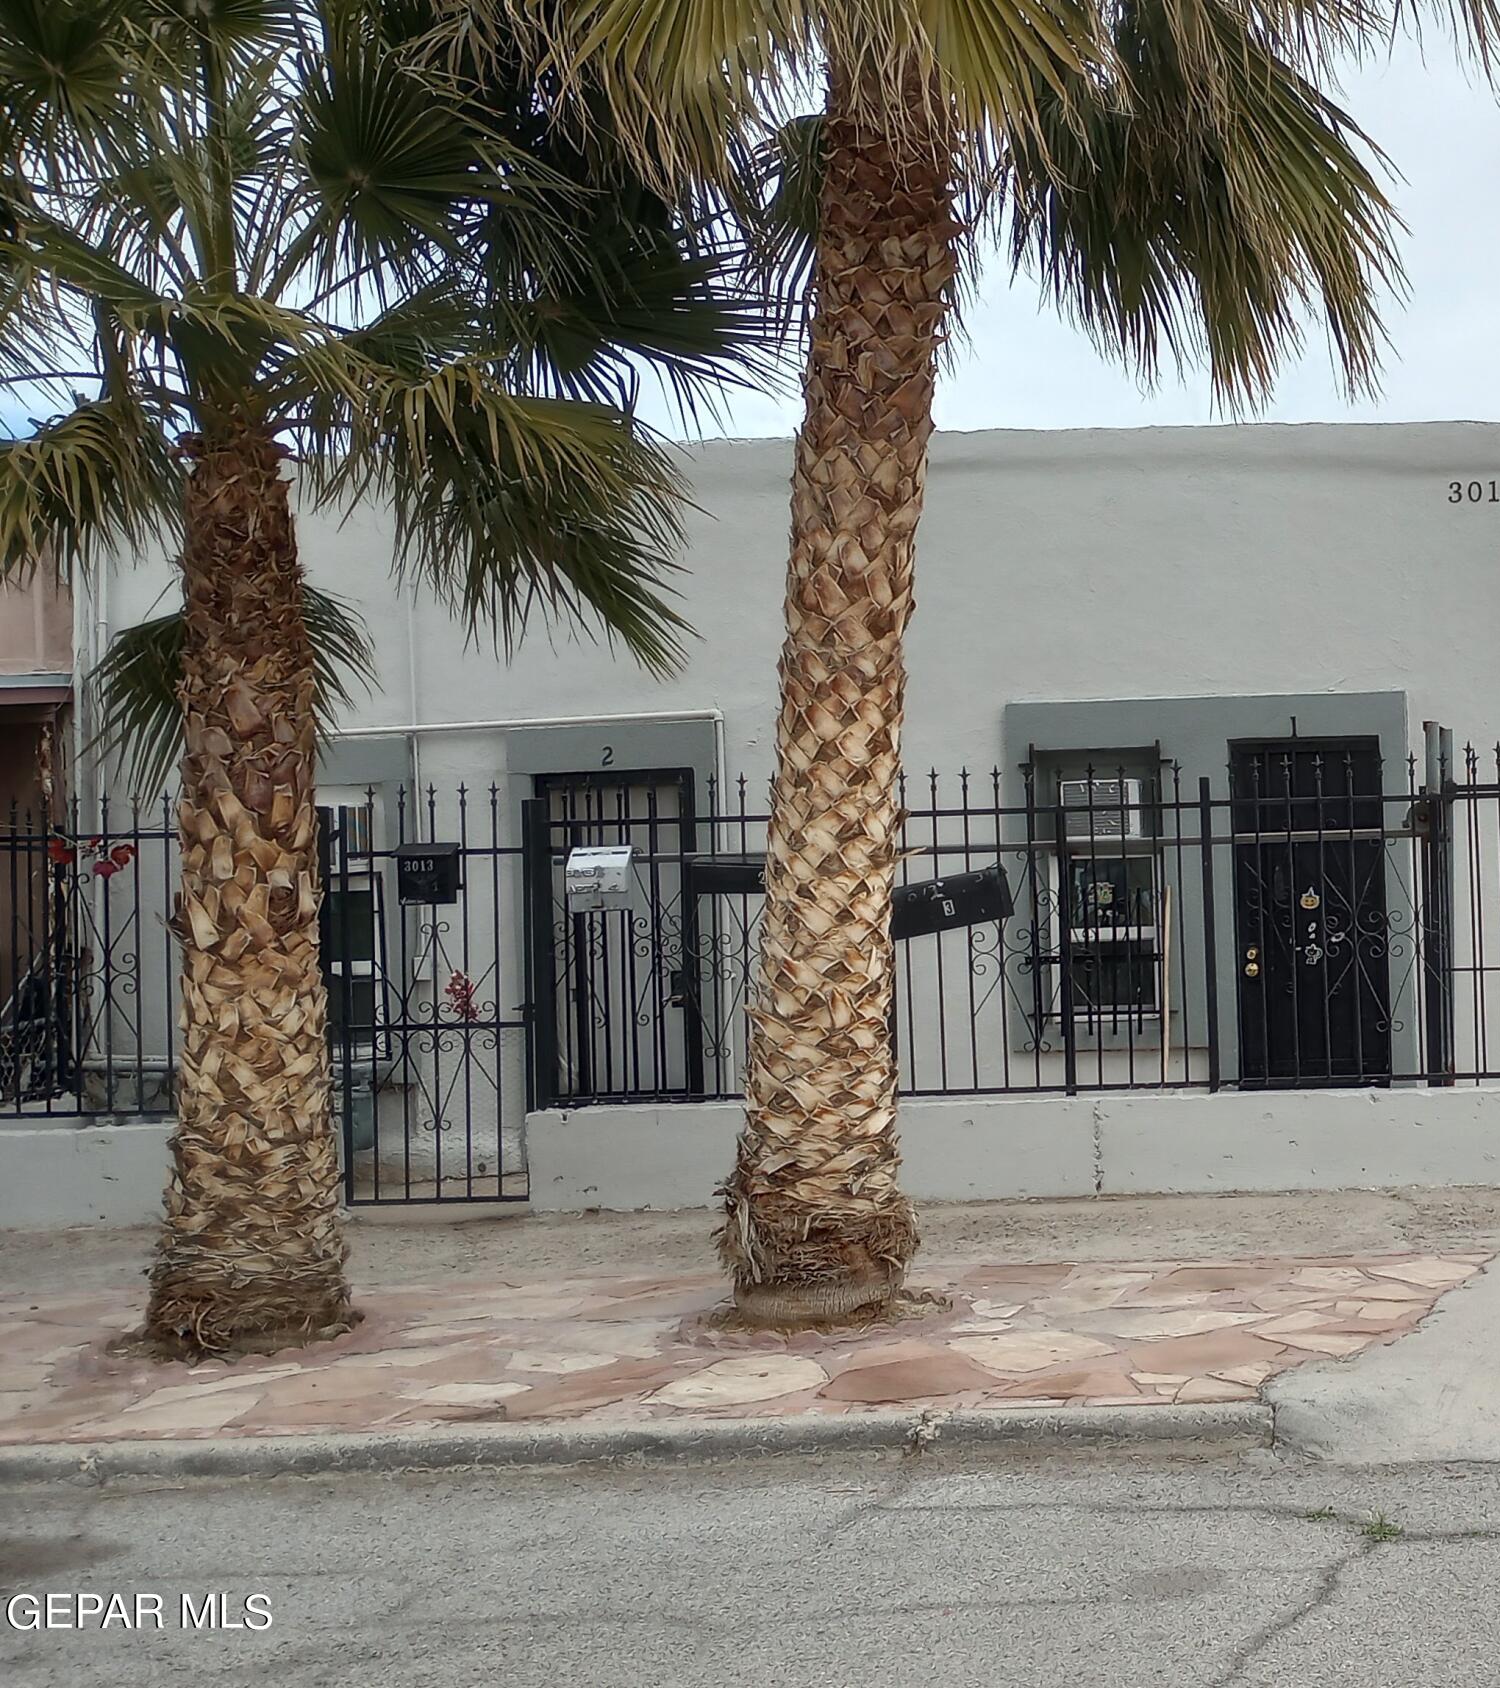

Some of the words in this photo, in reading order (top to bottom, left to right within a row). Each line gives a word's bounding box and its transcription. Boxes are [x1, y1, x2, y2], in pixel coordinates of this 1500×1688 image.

[602, 746, 614, 767] 2
[403, 859, 434, 872] 3013
[944, 902, 954, 915] 3
